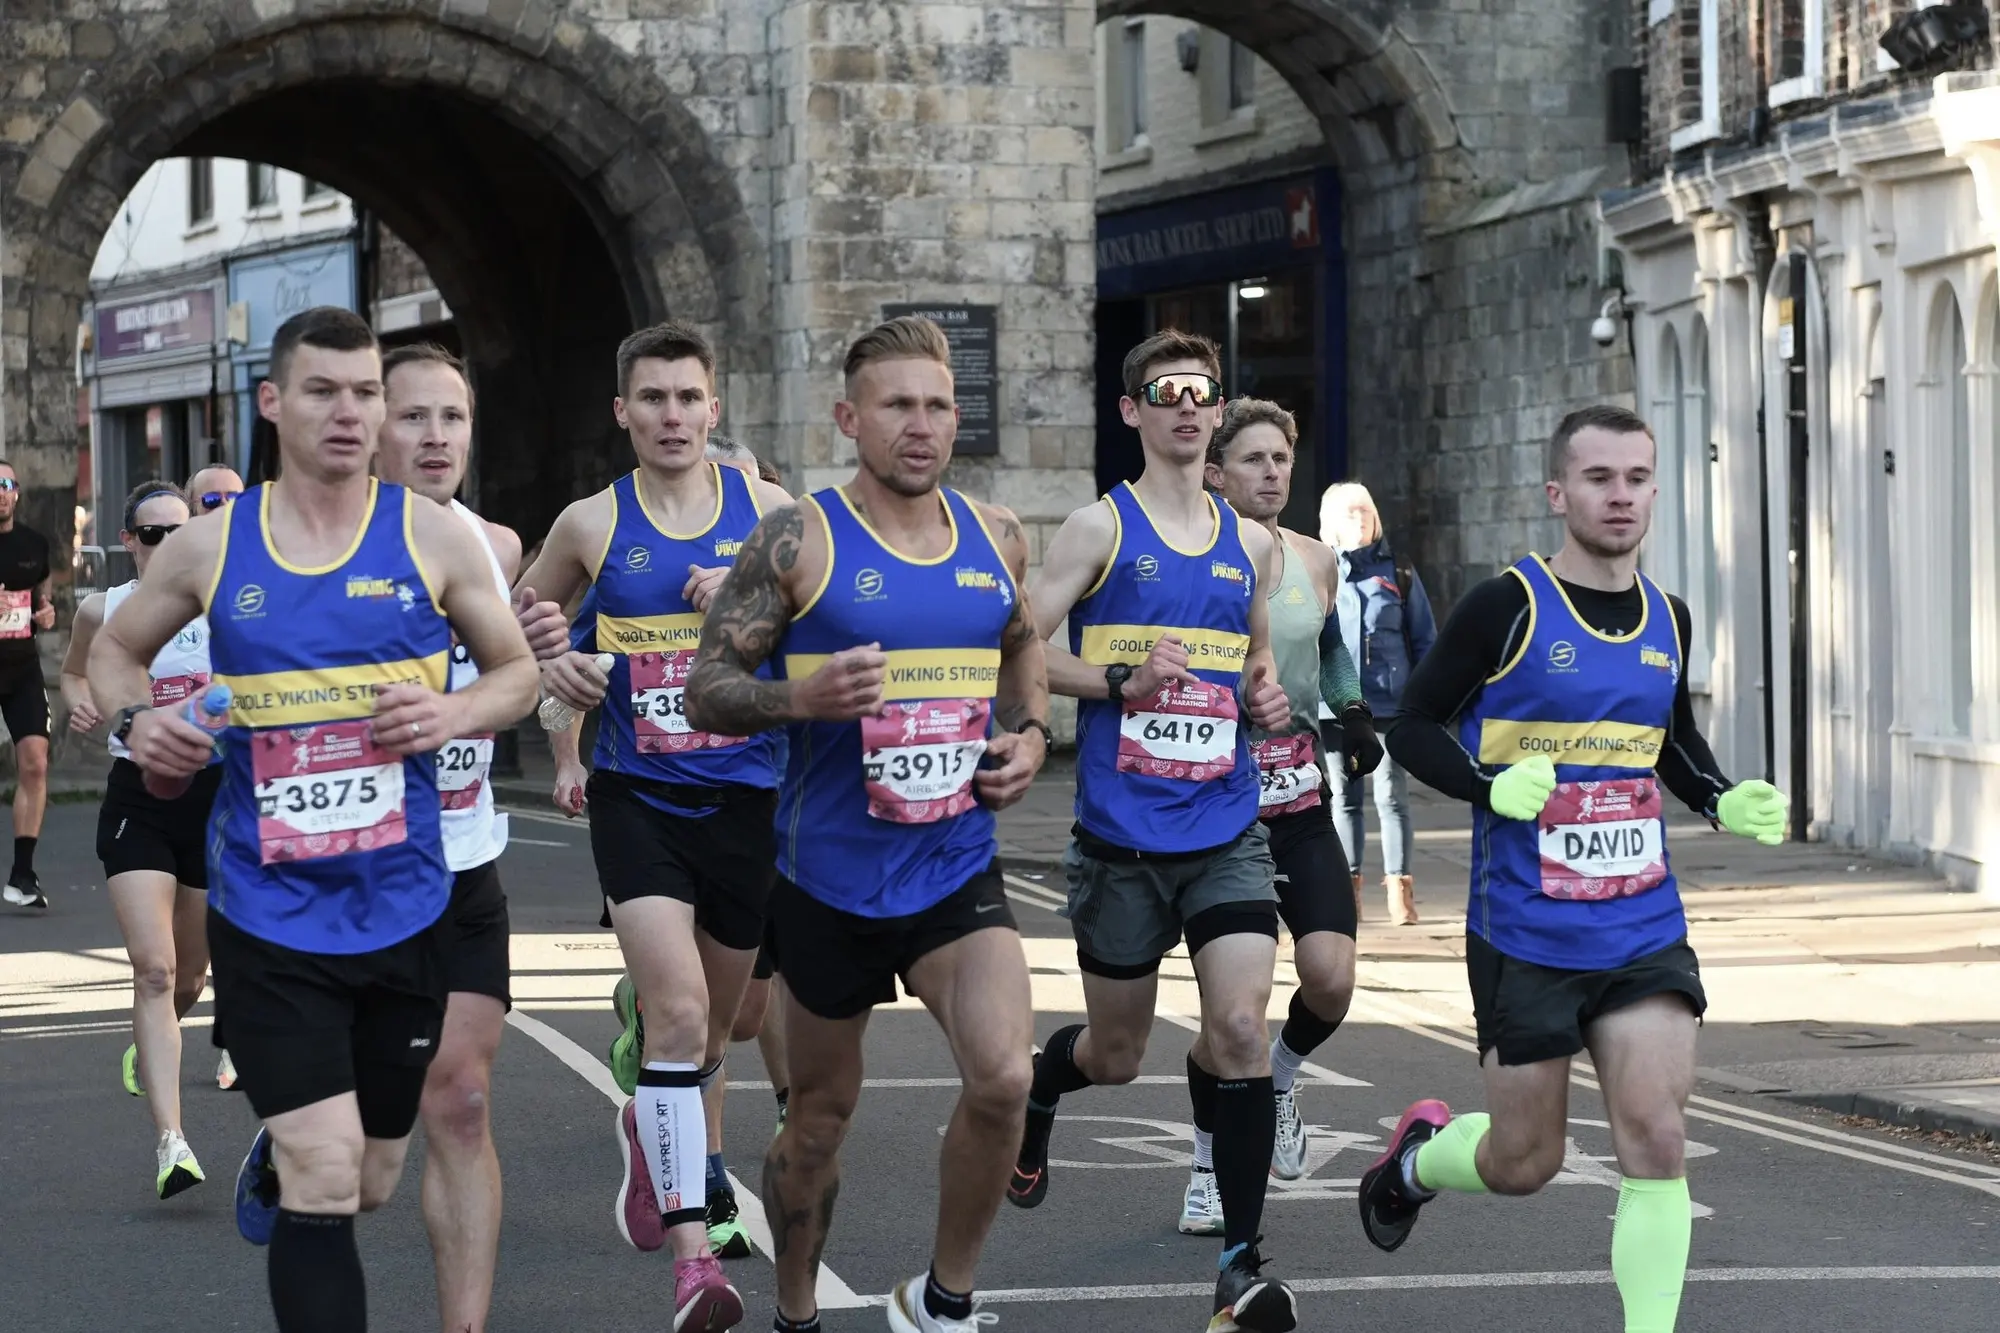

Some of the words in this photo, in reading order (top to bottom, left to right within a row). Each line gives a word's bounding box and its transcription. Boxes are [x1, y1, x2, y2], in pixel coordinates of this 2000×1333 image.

[949, 310, 969, 320] BAR
[955, 572, 997, 588] VIKING
[1211, 564, 1244, 581] VIKING
[615, 631, 657, 643] GOOLE
[1109, 639, 1154, 652] GOOLE
[890, 667, 945, 683] VIKING
[276, 687, 341, 707] VIKING
[1171, 699, 1209, 708] MARATHON
[1172, 692, 1209, 702] YORKSHIRE
[919, 726, 961, 736] MARATHON
[1142, 719, 1215, 745] 6419
[1519, 736, 1573, 751] GOOLE
[1575, 736, 1625, 751] VIKING
[891, 748, 964, 781] 3915
[867, 767, 880, 778] M
[286, 775, 379, 813] 3875
[1262, 792, 1289, 803] ROBIN
[310, 811, 361, 827] STEFAN
[1564, 827, 1644, 861] DAVID
